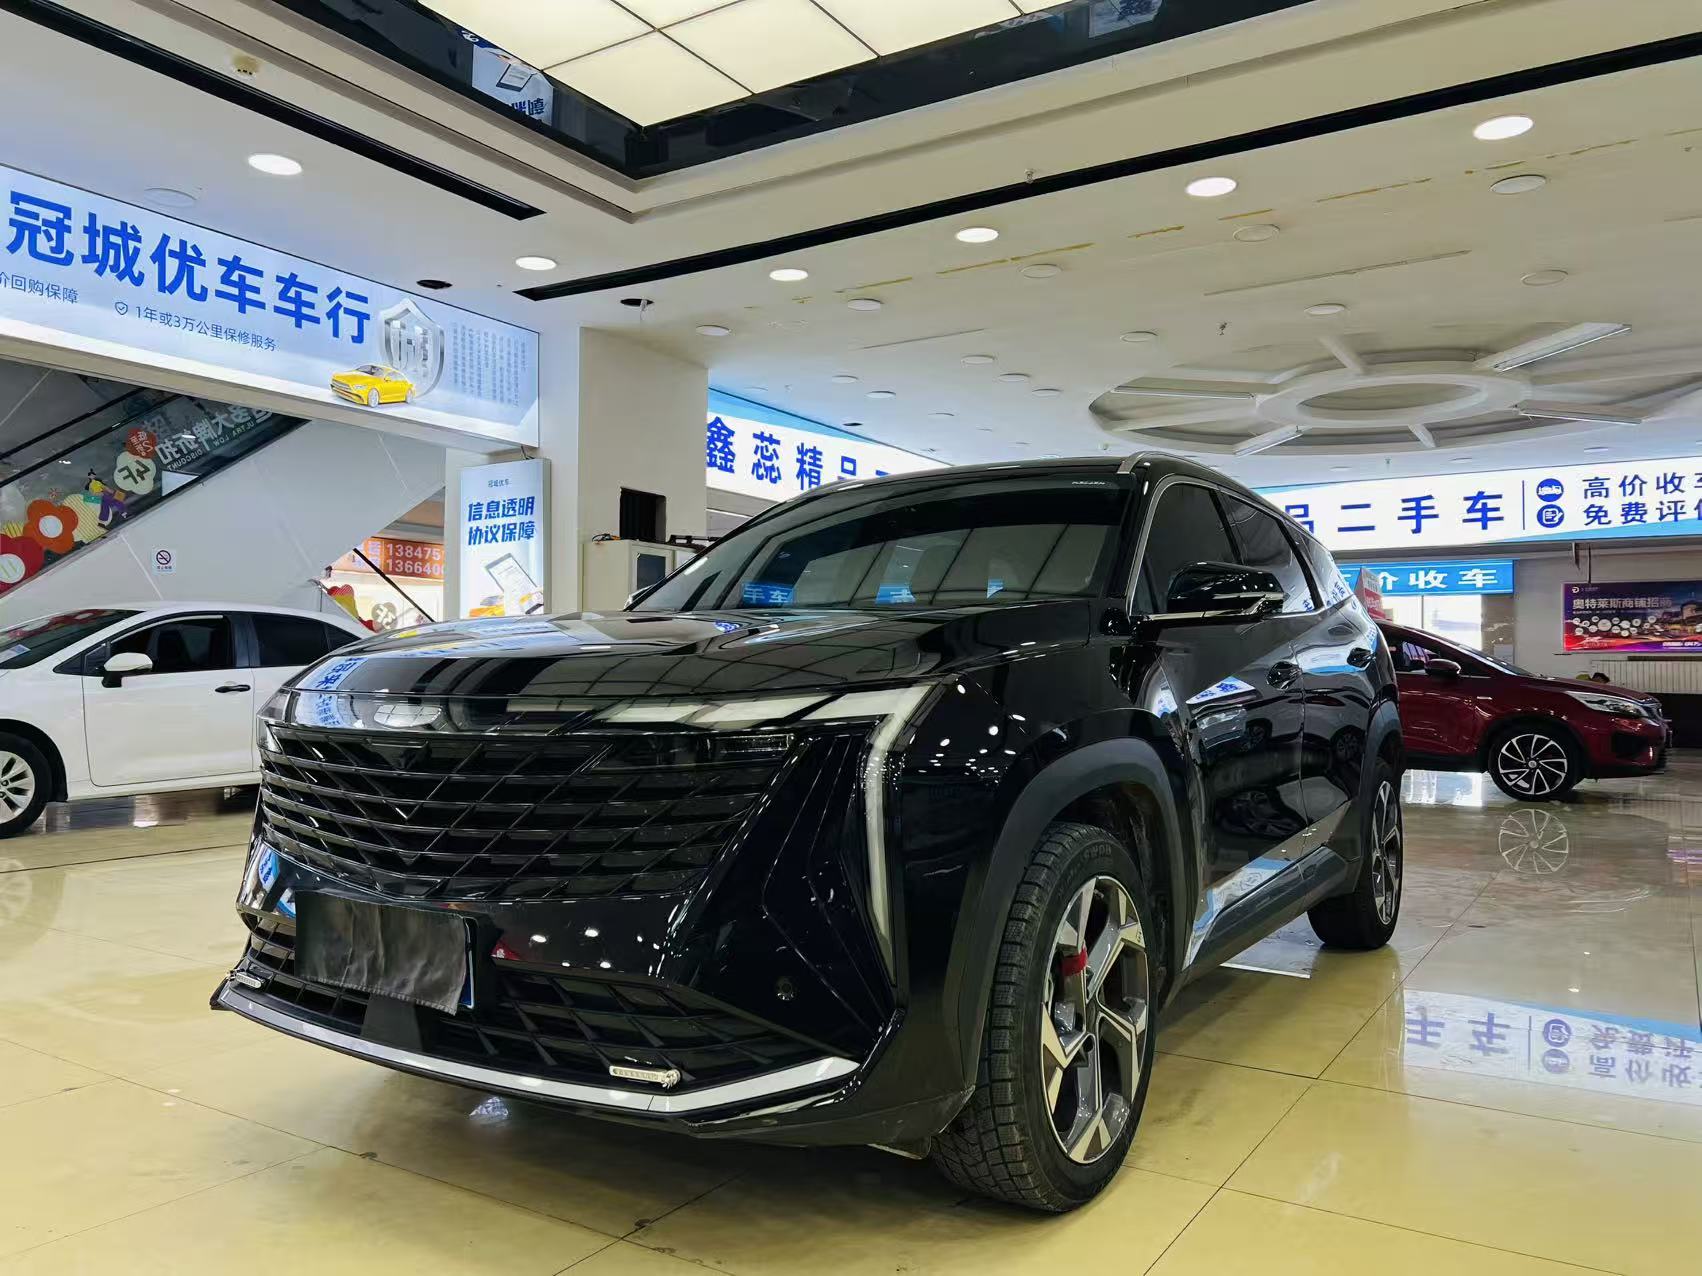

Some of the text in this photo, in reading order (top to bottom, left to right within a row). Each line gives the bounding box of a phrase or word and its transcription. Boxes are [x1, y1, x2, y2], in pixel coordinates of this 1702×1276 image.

[6, 190, 371, 344] 冠城优车车行
[135, 306, 278, 352] 1年或3万公里保修服务
[706, 416, 891, 491] 鑫蕊精
[467, 496, 536, 522] 信息透明
[468, 520, 536, 546] 协议保障
[386, 543, 444, 561] 138475
[386, 558, 444, 576] 136640
[1341, 568, 1499, 591] 价收车
